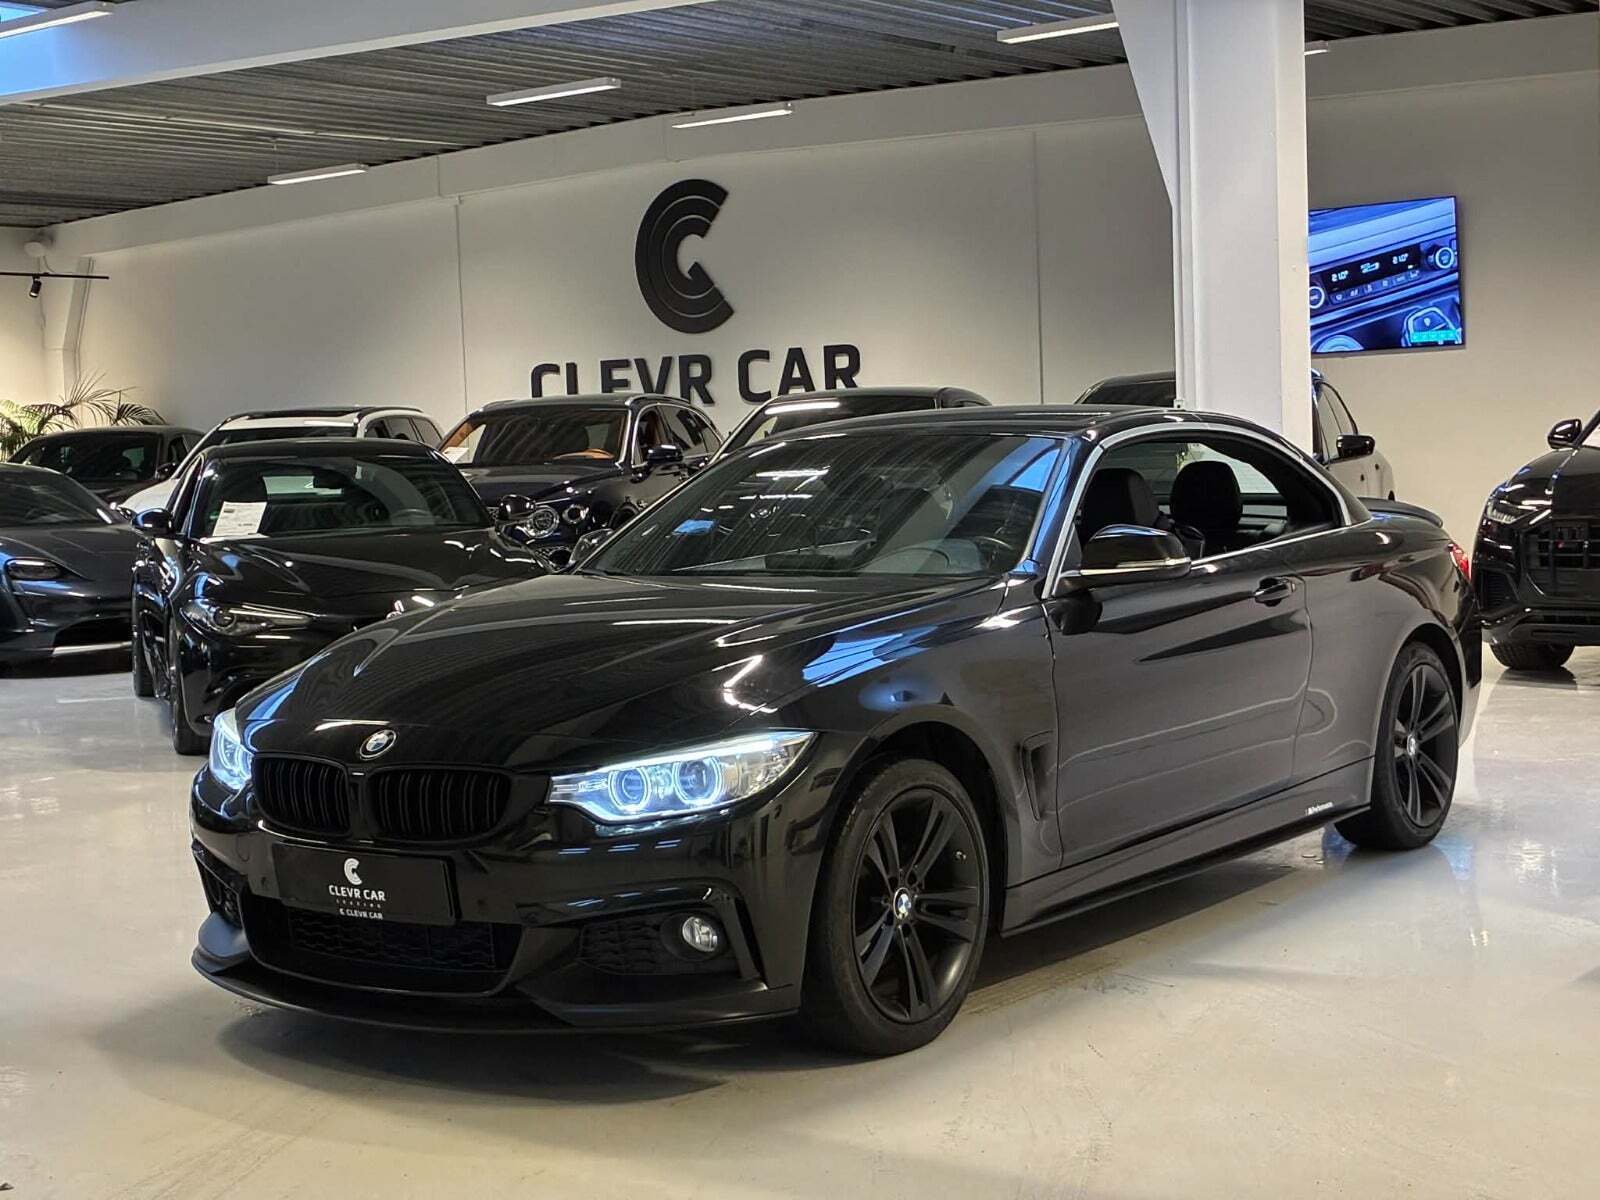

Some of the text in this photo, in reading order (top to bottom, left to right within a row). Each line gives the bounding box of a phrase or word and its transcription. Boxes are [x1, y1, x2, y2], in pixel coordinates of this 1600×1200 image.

[530, 344, 861, 405] CLEVR CAR
[328, 885, 386, 902] CLEVR CAR
[346, 908, 368, 918] CLEVR
[369, 911, 383, 920] CAR
